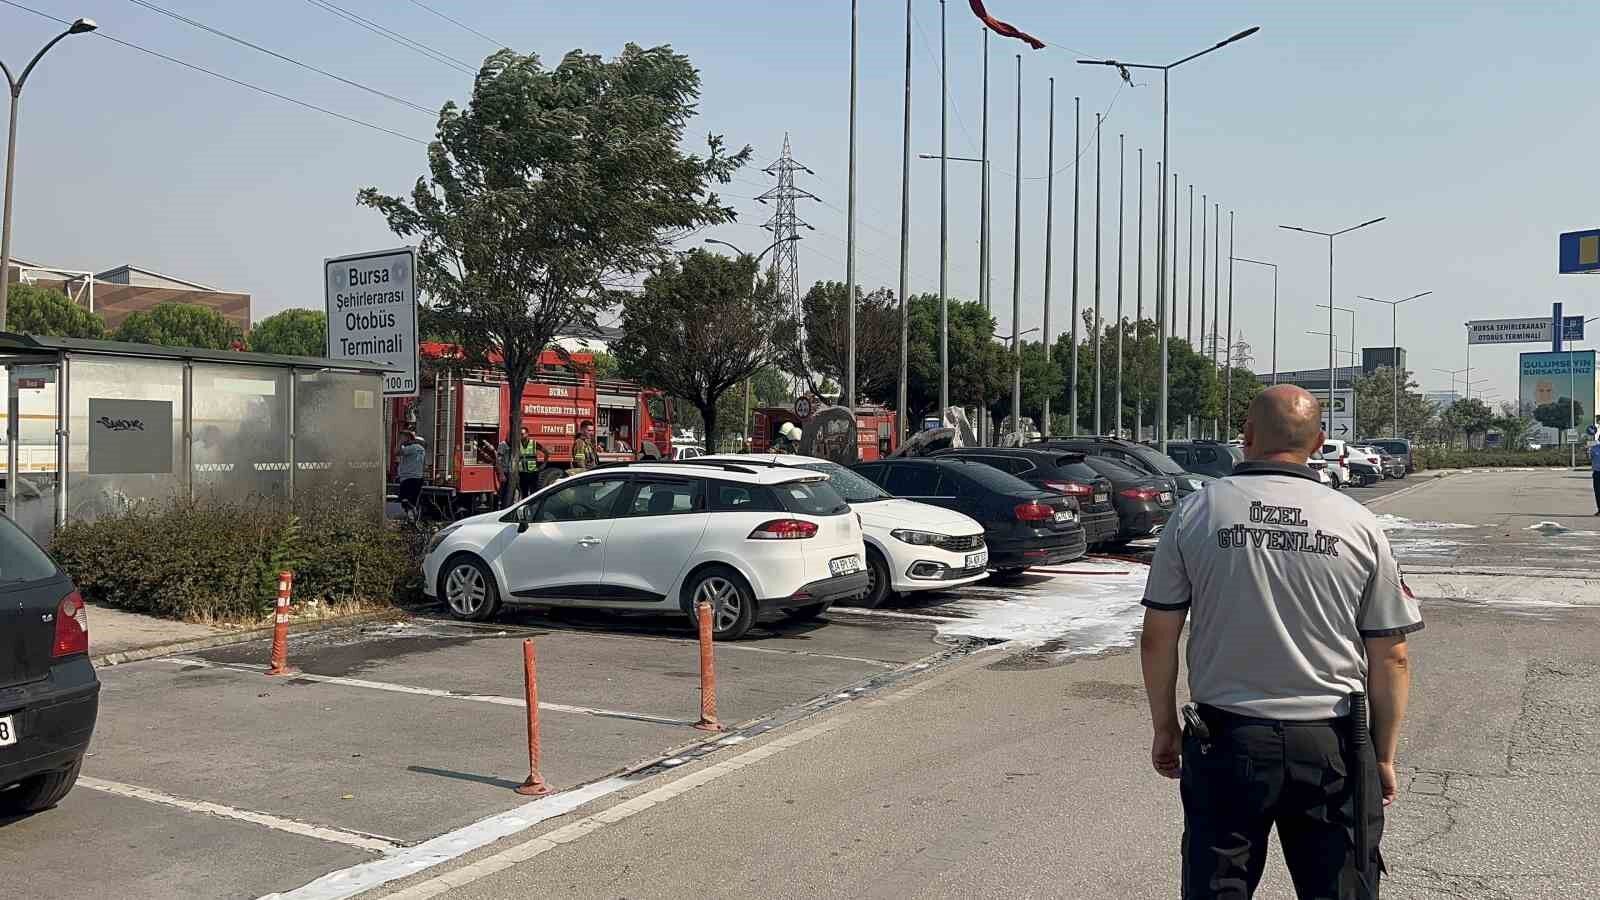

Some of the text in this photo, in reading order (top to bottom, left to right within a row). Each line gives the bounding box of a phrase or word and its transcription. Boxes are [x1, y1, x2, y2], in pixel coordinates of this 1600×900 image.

[349, 268, 389, 286] Bursa
[337, 290, 404, 312] Şehirlerarası
[346, 310, 395, 331] Otobüs
[1473, 324, 1494, 332] BURSA
[340, 333, 402, 356] Terminali
[386, 378, 413, 389] 100 m
[1249, 501, 1308, 527] ÖZEL
[1218, 524, 1339, 557] GÜVENLİK
